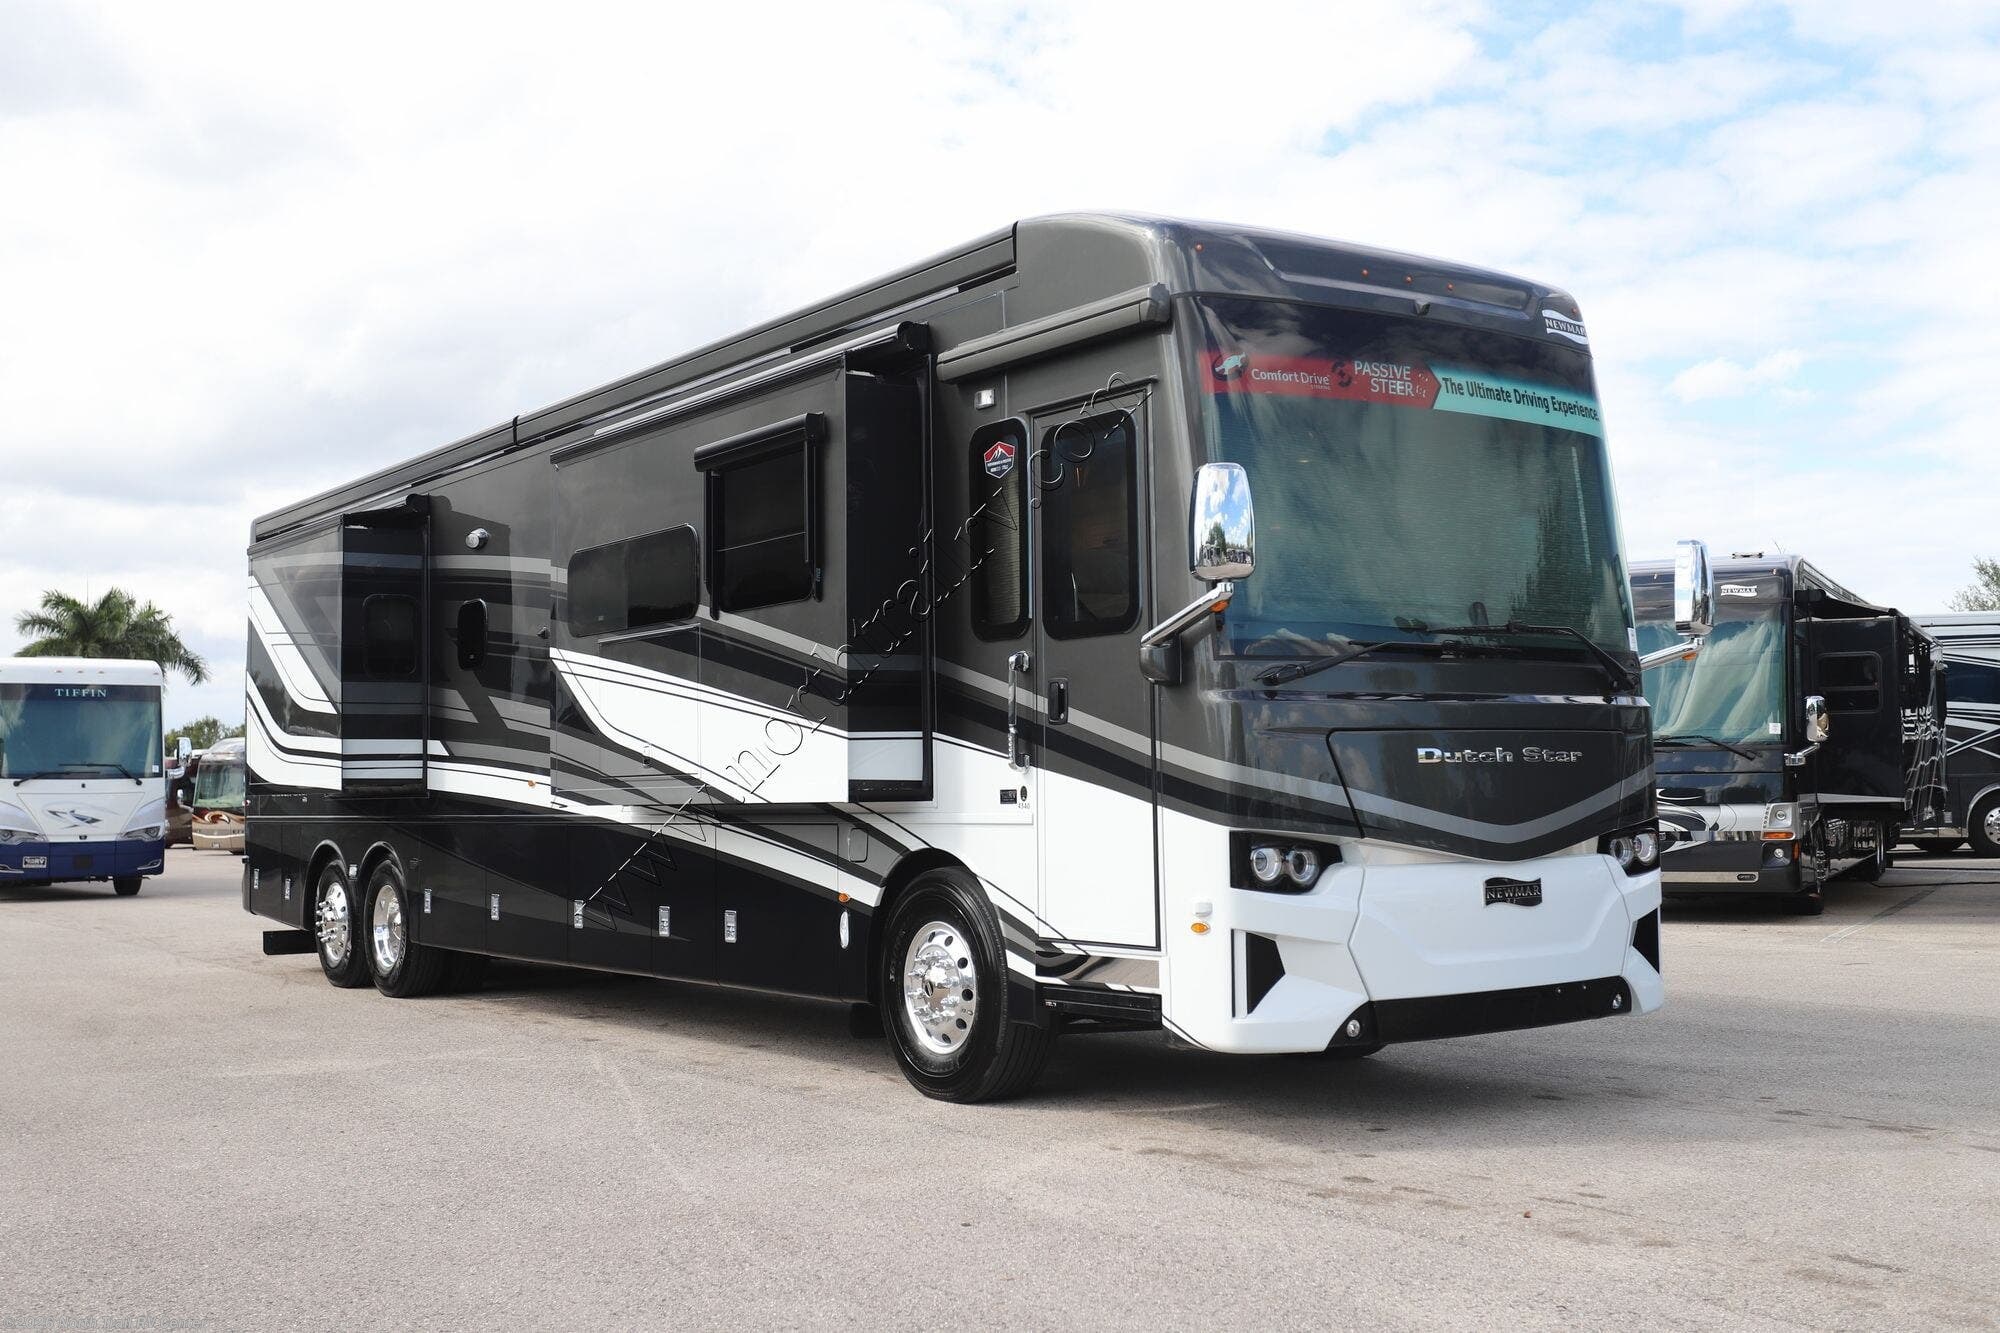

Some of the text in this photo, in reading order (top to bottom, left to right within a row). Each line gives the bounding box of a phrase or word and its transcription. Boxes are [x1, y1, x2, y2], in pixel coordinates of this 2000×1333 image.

[1251, 367, 1330, 386] Comfort Drive
[1354, 360, 1412, 381] PASSIVE
[1370, 377, 1415, 397] STEER
[1442, 376, 1465, 396] The
[1466, 380, 1513, 404] Ultimate
[1513, 387, 1550, 414] Driving
[54, 688, 107, 698] TIFFIN
[1416, 746, 1583, 764] Dutch Star
[1486, 885, 1542, 899] NEWMAR
